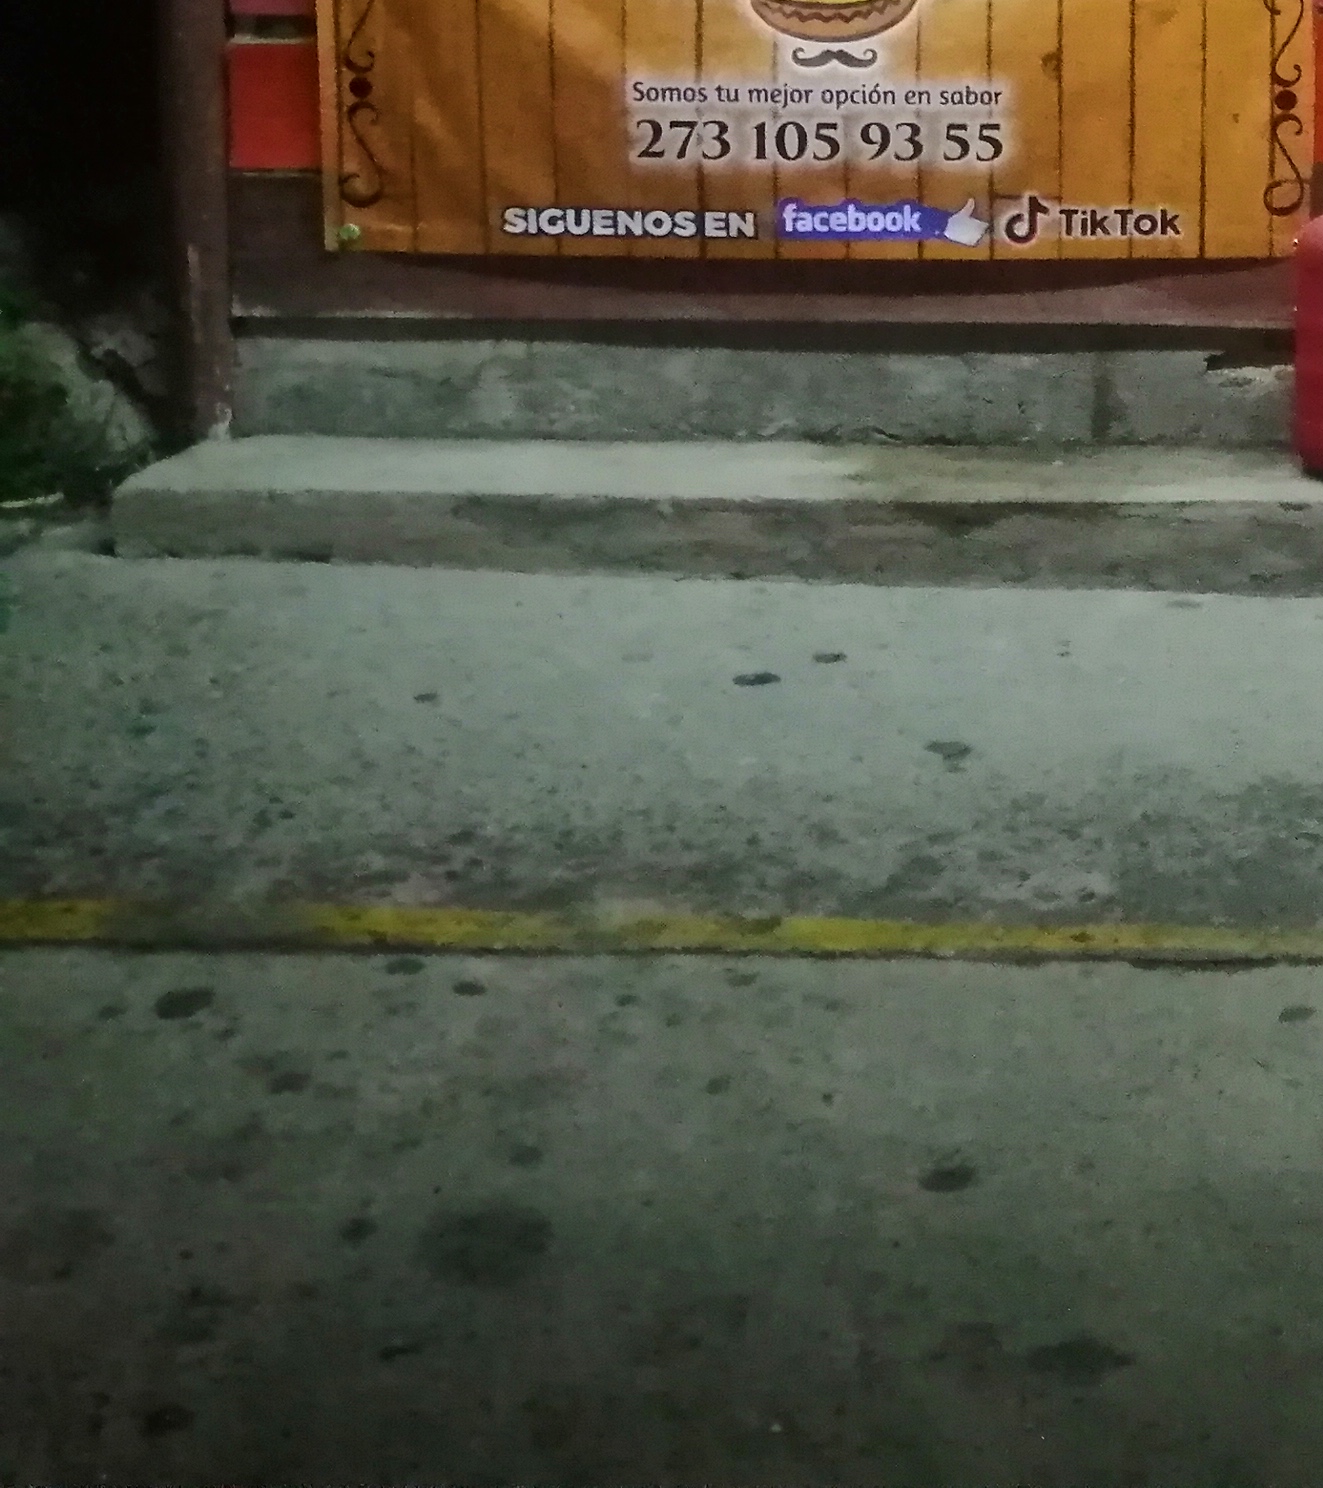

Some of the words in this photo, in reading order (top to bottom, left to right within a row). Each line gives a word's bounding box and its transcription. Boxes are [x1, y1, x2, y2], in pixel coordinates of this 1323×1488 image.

[632, 81, 708, 104] Somos
[715, 84, 740, 104] tu
[747, 84, 813, 110] mejor
[821, 82, 896, 111] opción
[904, 87, 932, 106] en
[939, 85, 1002, 107] sabor
[636, 119, 732, 161] 273
[752, 120, 841, 162] 105
[859, 121, 924, 162] 93
[942, 122, 1003, 163] 55
[503, 207, 697, 238] SIGUENOS
[703, 211, 756, 240] EN
[782, 203, 922, 235] facebook
